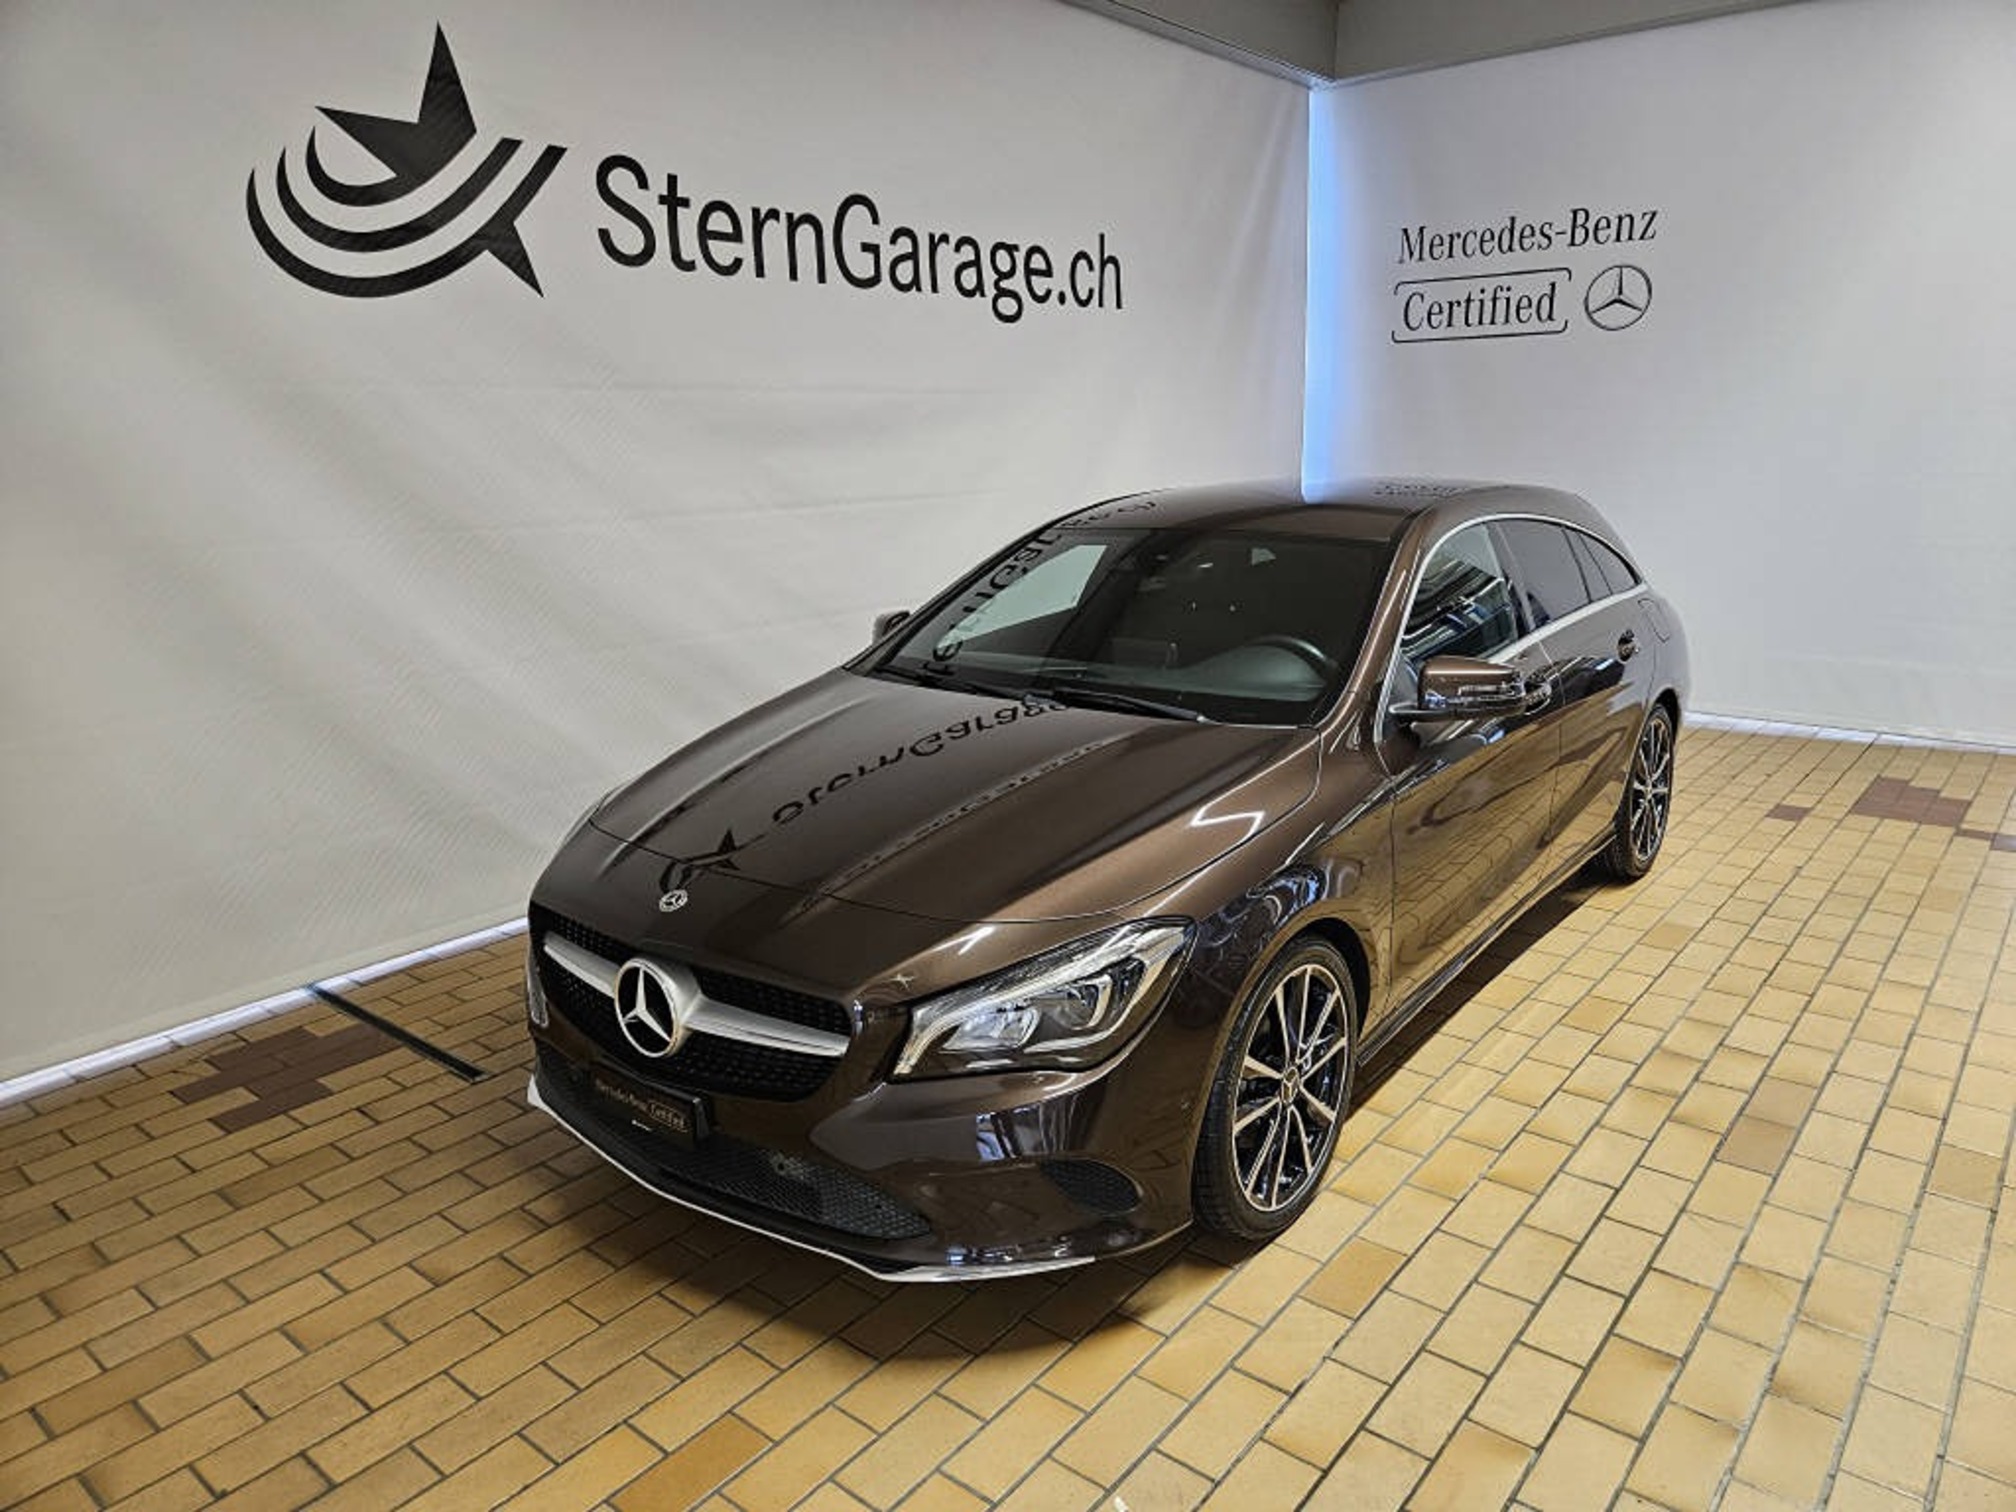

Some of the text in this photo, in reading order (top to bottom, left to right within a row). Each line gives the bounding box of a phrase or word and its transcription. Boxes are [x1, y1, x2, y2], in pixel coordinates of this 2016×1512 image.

[595, 154, 1123, 324] SternGarage.ch
[1399, 207, 1659, 264] Mercedes-Benz
[1403, 281, 1557, 332] Certified
